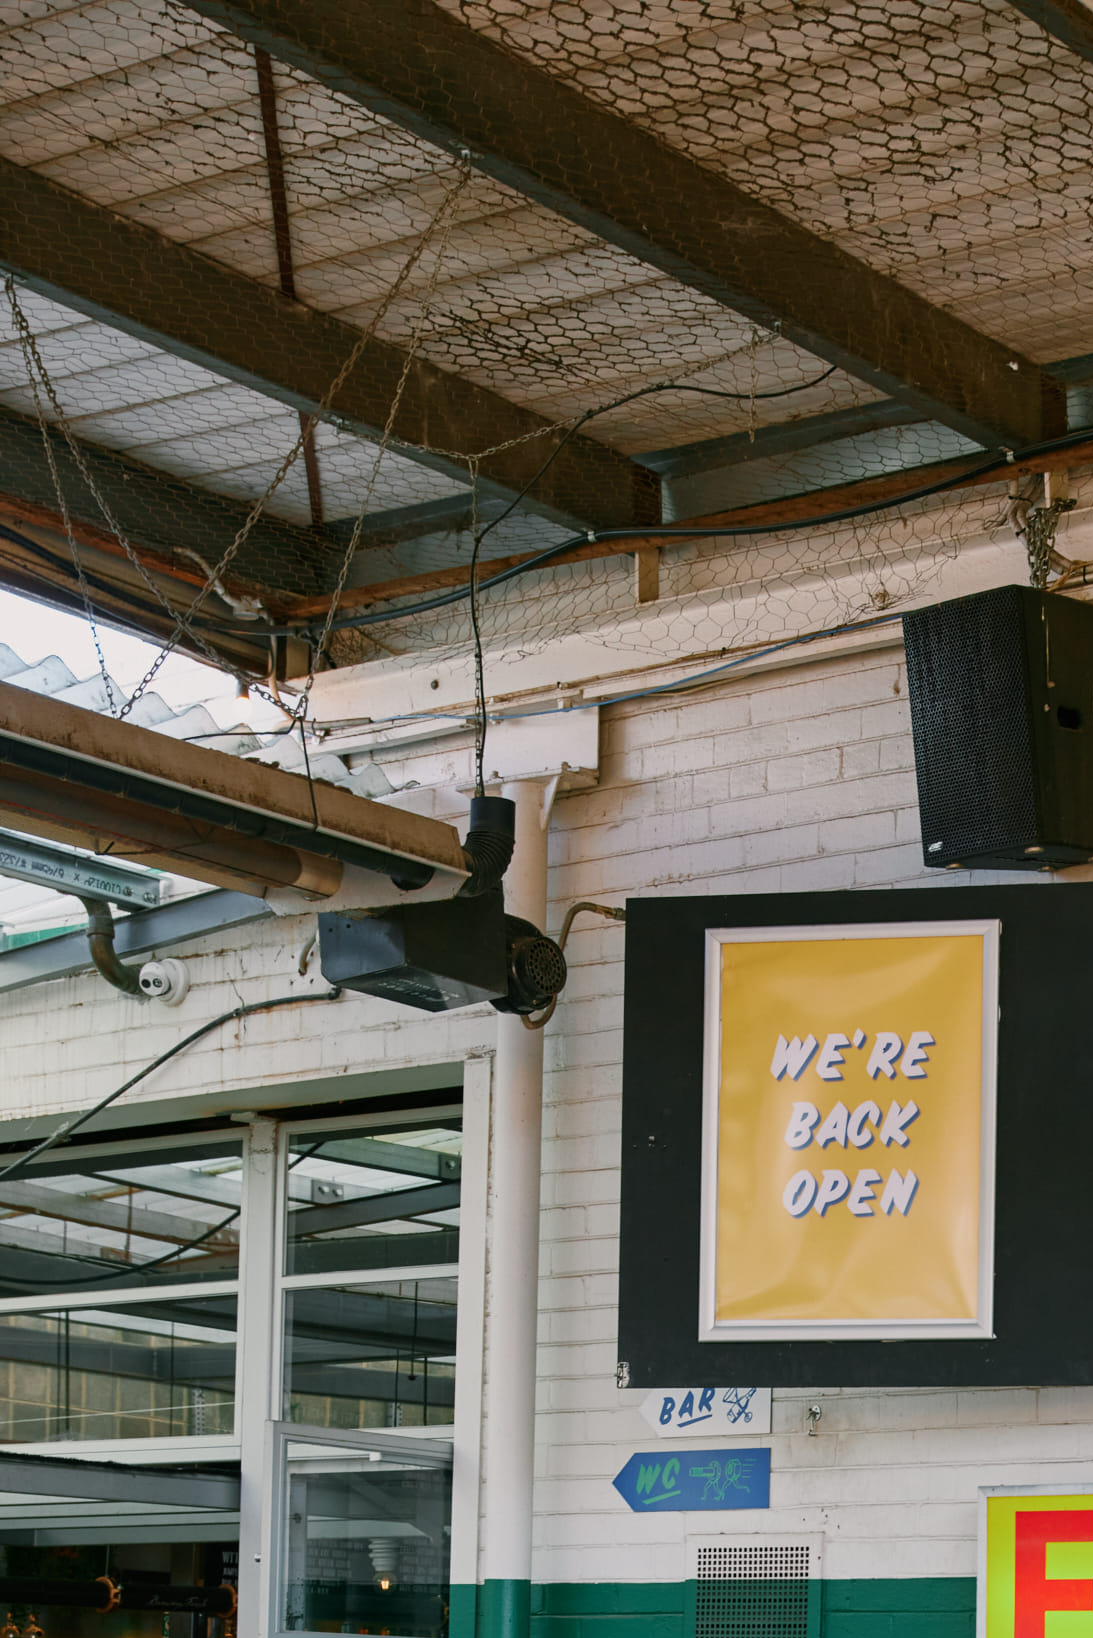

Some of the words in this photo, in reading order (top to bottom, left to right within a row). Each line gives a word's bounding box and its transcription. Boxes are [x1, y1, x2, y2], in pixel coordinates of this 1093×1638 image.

[770, 1028, 936, 1082] WE'RE
[784, 1100, 921, 1150] BACK
[782, 1168, 920, 1219] OPEN
[659, 1388, 716, 1425] BAR
[636, 1457, 680, 1495] WC
